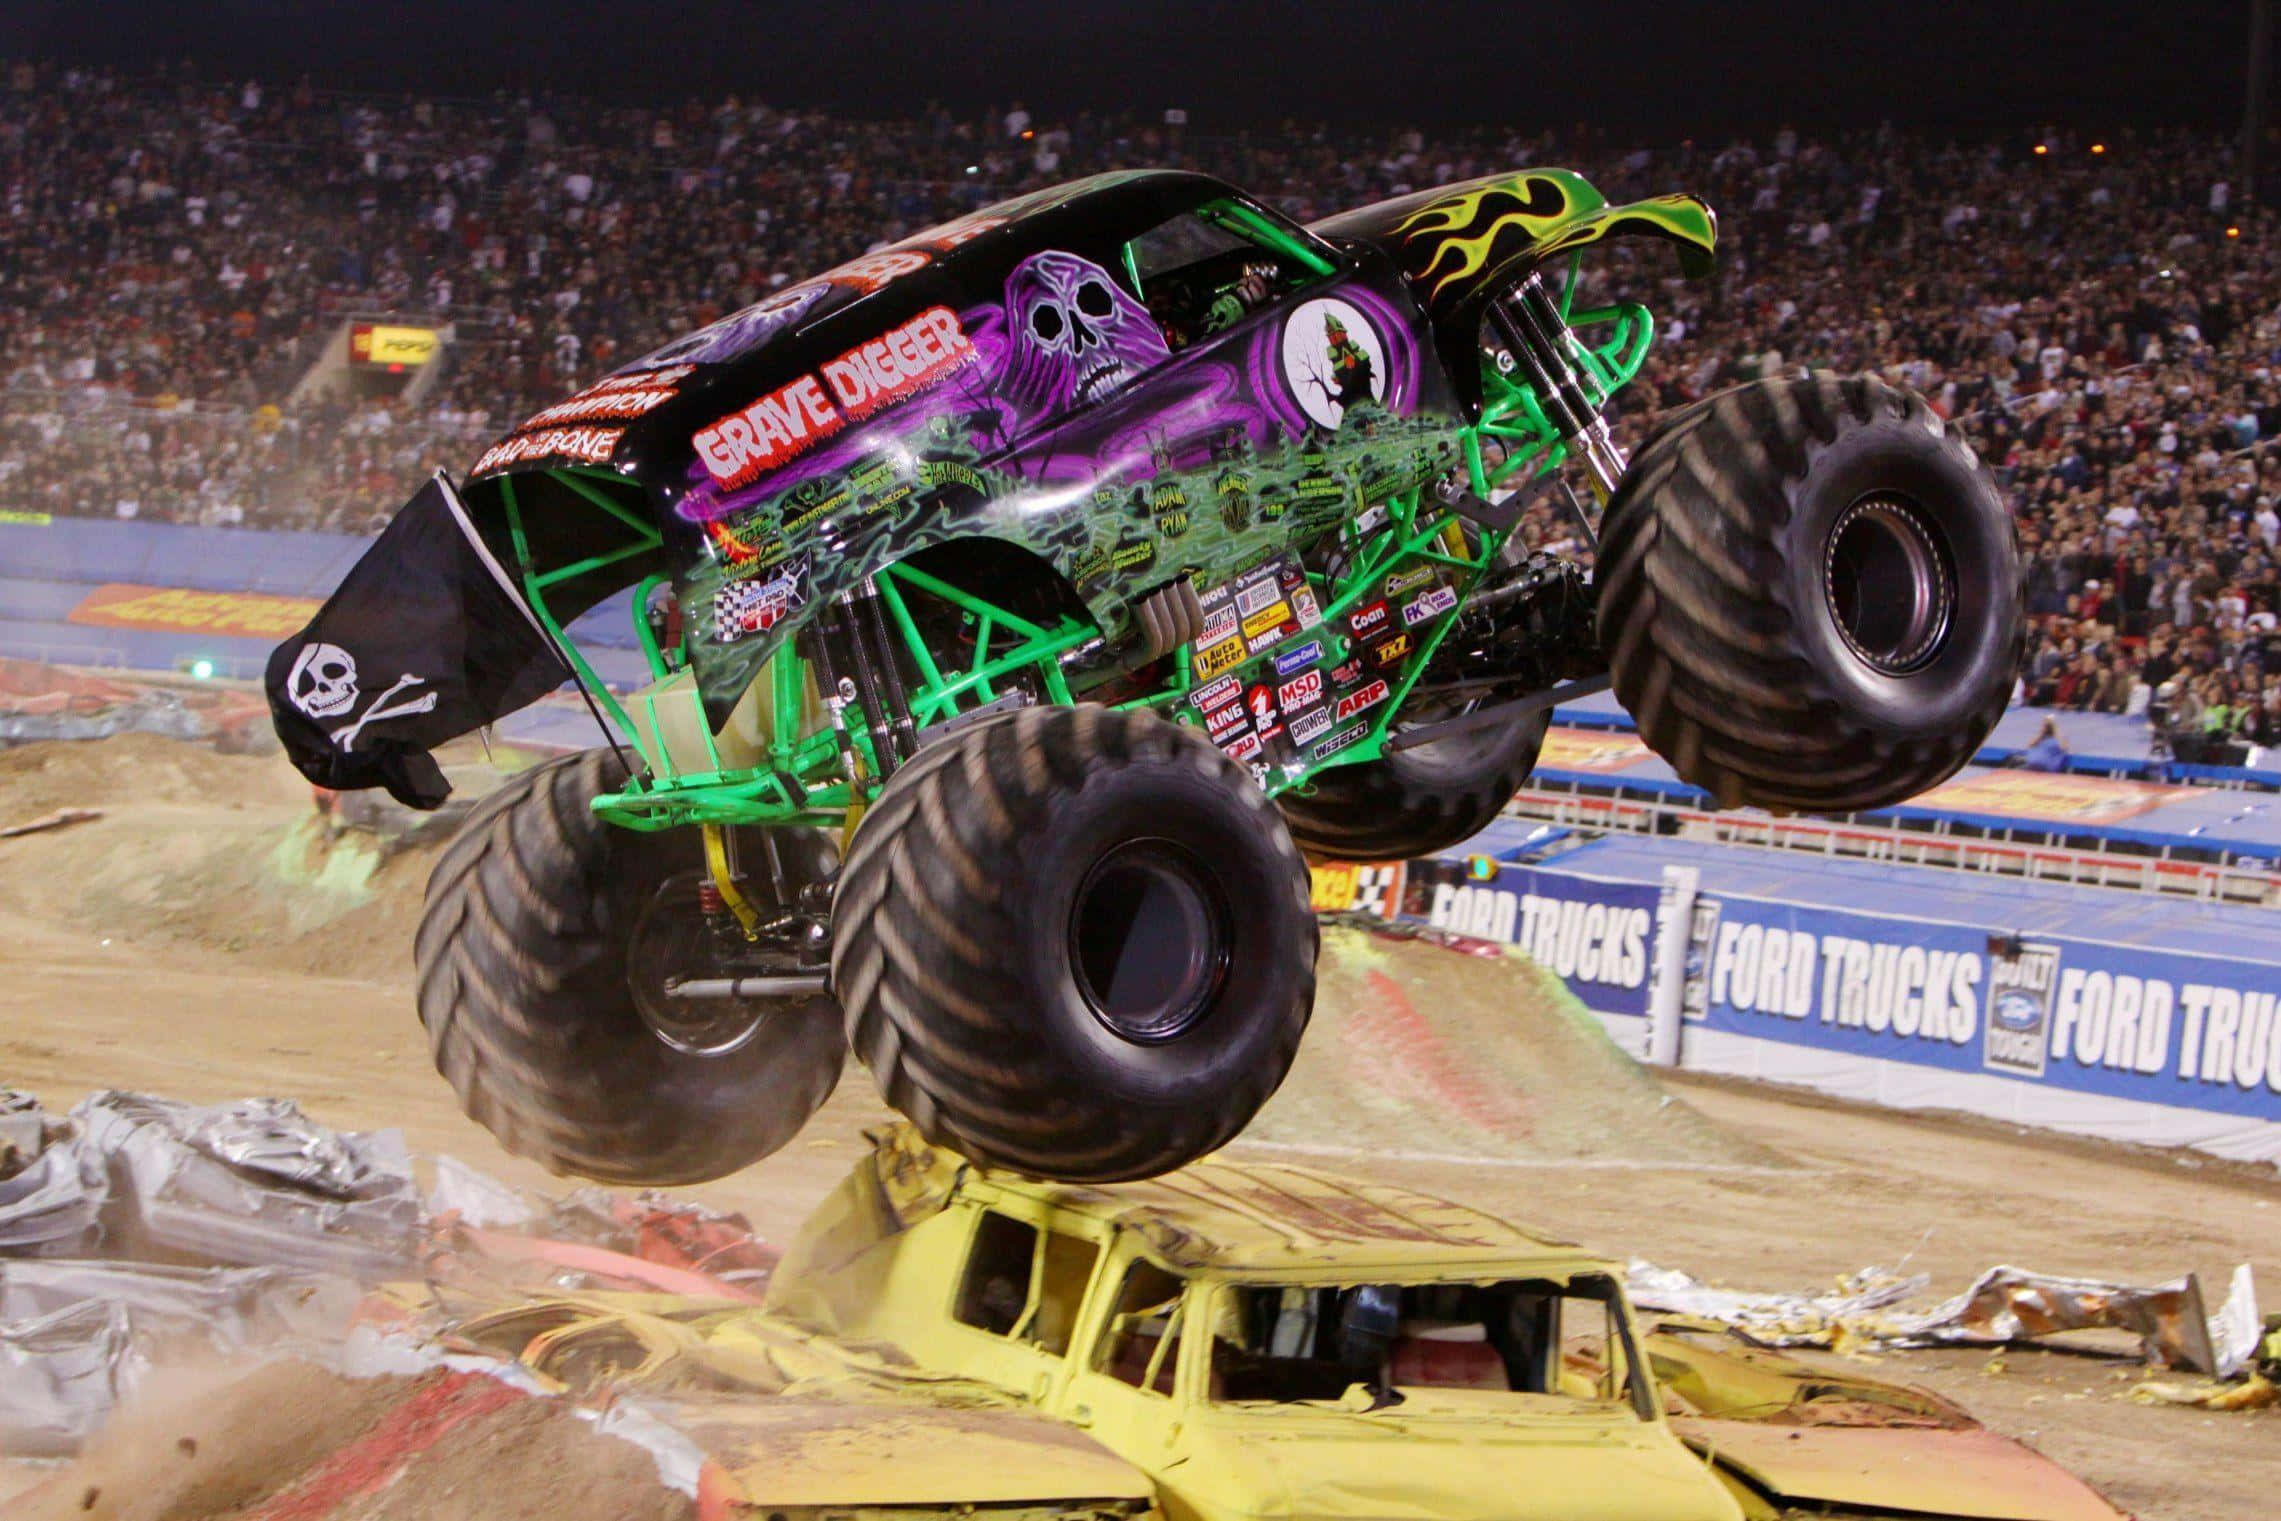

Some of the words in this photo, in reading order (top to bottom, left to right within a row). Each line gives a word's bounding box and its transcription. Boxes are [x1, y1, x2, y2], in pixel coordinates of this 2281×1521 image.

[693, 373, 841, 480] GRAVE
[824, 306, 970, 406] DIGGER
[473, 436, 528, 474] BAD
[541, 429, 621, 459] BONE
[1161, 513, 1187, 537] RYAN
[1351, 607, 1385, 630] Coan
[1405, 604, 1425, 622] FK
[1210, 641, 1235, 660] Auto
[1248, 627, 1283, 654] HAWK
[1211, 648, 1243, 674] Meter
[1192, 677, 1232, 706] LINCOLN
[1281, 675, 1320, 706] MSD
[1338, 682, 1386, 719] ARP
[1206, 703, 1245, 733] KING
[1291, 707, 1329, 738] CROWER
[1430, 883, 1517, 944] FORD
[1520, 893, 1650, 988] TRUCKS
[1711, 920, 1818, 1018] FORD
[1821, 934, 1982, 1044] TRUCKS
[2051, 967, 2173, 1074] FORD
